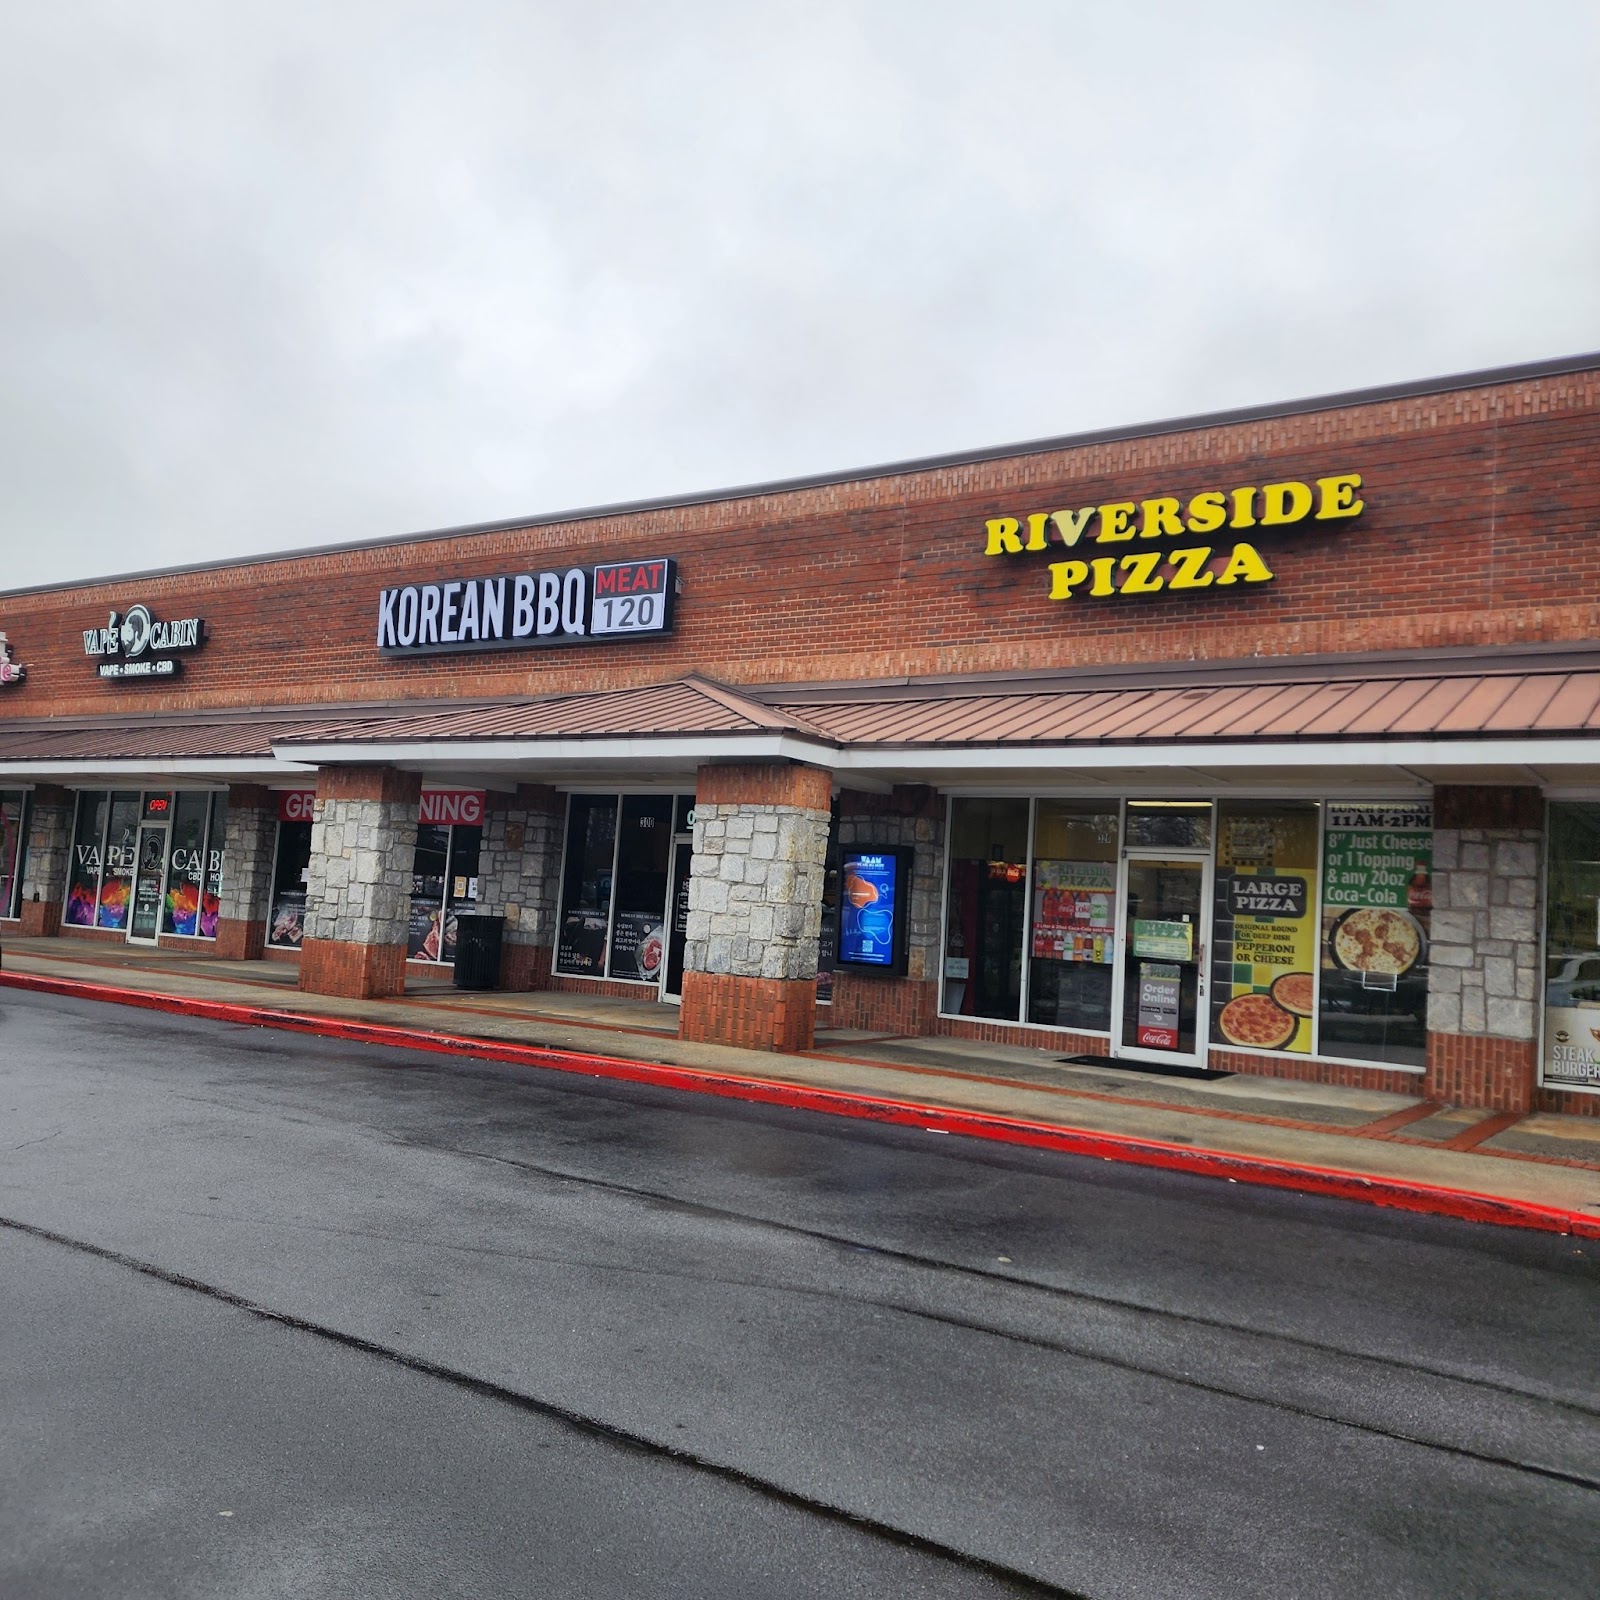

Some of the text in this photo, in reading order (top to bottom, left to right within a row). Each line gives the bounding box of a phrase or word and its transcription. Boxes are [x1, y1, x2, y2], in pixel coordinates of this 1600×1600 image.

[984, 473, 1364, 556] RIVERSIDE
[597, 564, 664, 593] MEAT
[1048, 542, 1274, 600] PIZZA
[377, 568, 586, 647] KOREAN BBQ
[602, 595, 655, 628] 120
[83, 618, 199, 655] VAPE CABIN
[99, 660, 173, 676] VAPE SMOKE CBD
[149, 799, 168, 811] OPEN
[639, 816, 655, 828] 300
[1331, 814, 1432, 827] 11AM-2PM
[1350, 833, 1378, 849] Just
[1382, 834, 1433, 850] Cheese
[75, 844, 135, 867] VAPE
[1328, 851, 1415, 870] or 1 Topping
[86, 866, 101, 875] VAPE
[112, 867, 134, 876] SMOKE
[188, 871, 202, 881] CBD
[1058, 863, 1112, 877] RIVERSIDE
[1328, 868, 1406, 887] & any 20oz
[1058, 875, 1113, 888] PIZZA
[1233, 881, 1302, 897] LARGE
[1327, 886, 1398, 904] Coca-Cola
[1236, 896, 1298, 912] PIZZA
[1068, 925, 1091, 933] Coca-Cola
[1235, 923, 1298, 934] ORIGINAL ROUND
[1236, 942, 1296, 954] PEPPERONI
[1236, 954, 1295, 965] OR CHEESE
[1144, 983, 1176, 995] Order
[1142, 993, 1177, 1005] Online
[1553, 1045, 1594, 1063] STEAK
